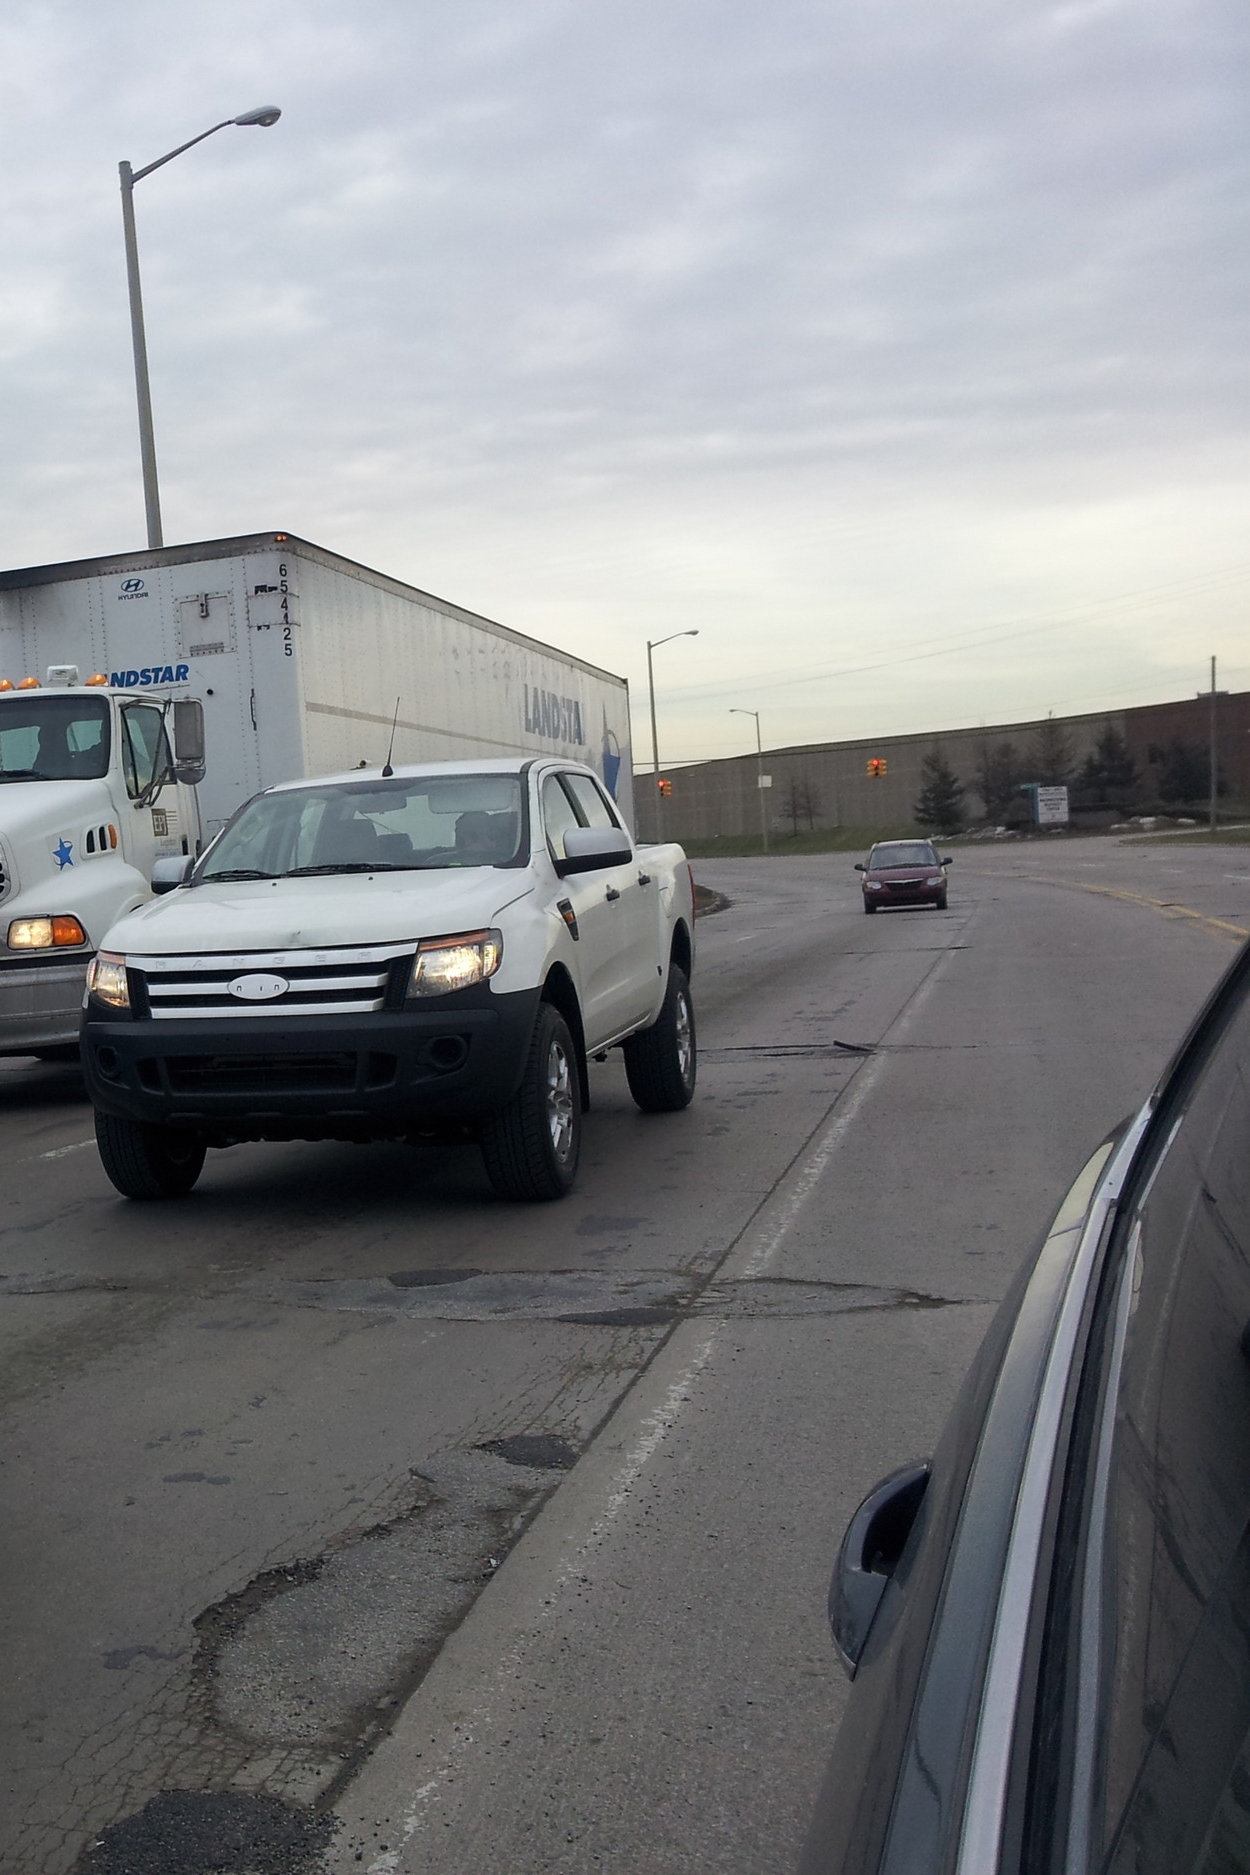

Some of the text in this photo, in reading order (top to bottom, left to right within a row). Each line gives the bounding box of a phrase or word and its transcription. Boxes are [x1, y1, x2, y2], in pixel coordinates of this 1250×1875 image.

[118, 592, 149, 601] HYUNDAI
[104, 664, 190, 688] NDSTAR
[523, 683, 586, 746] LANDSTA
